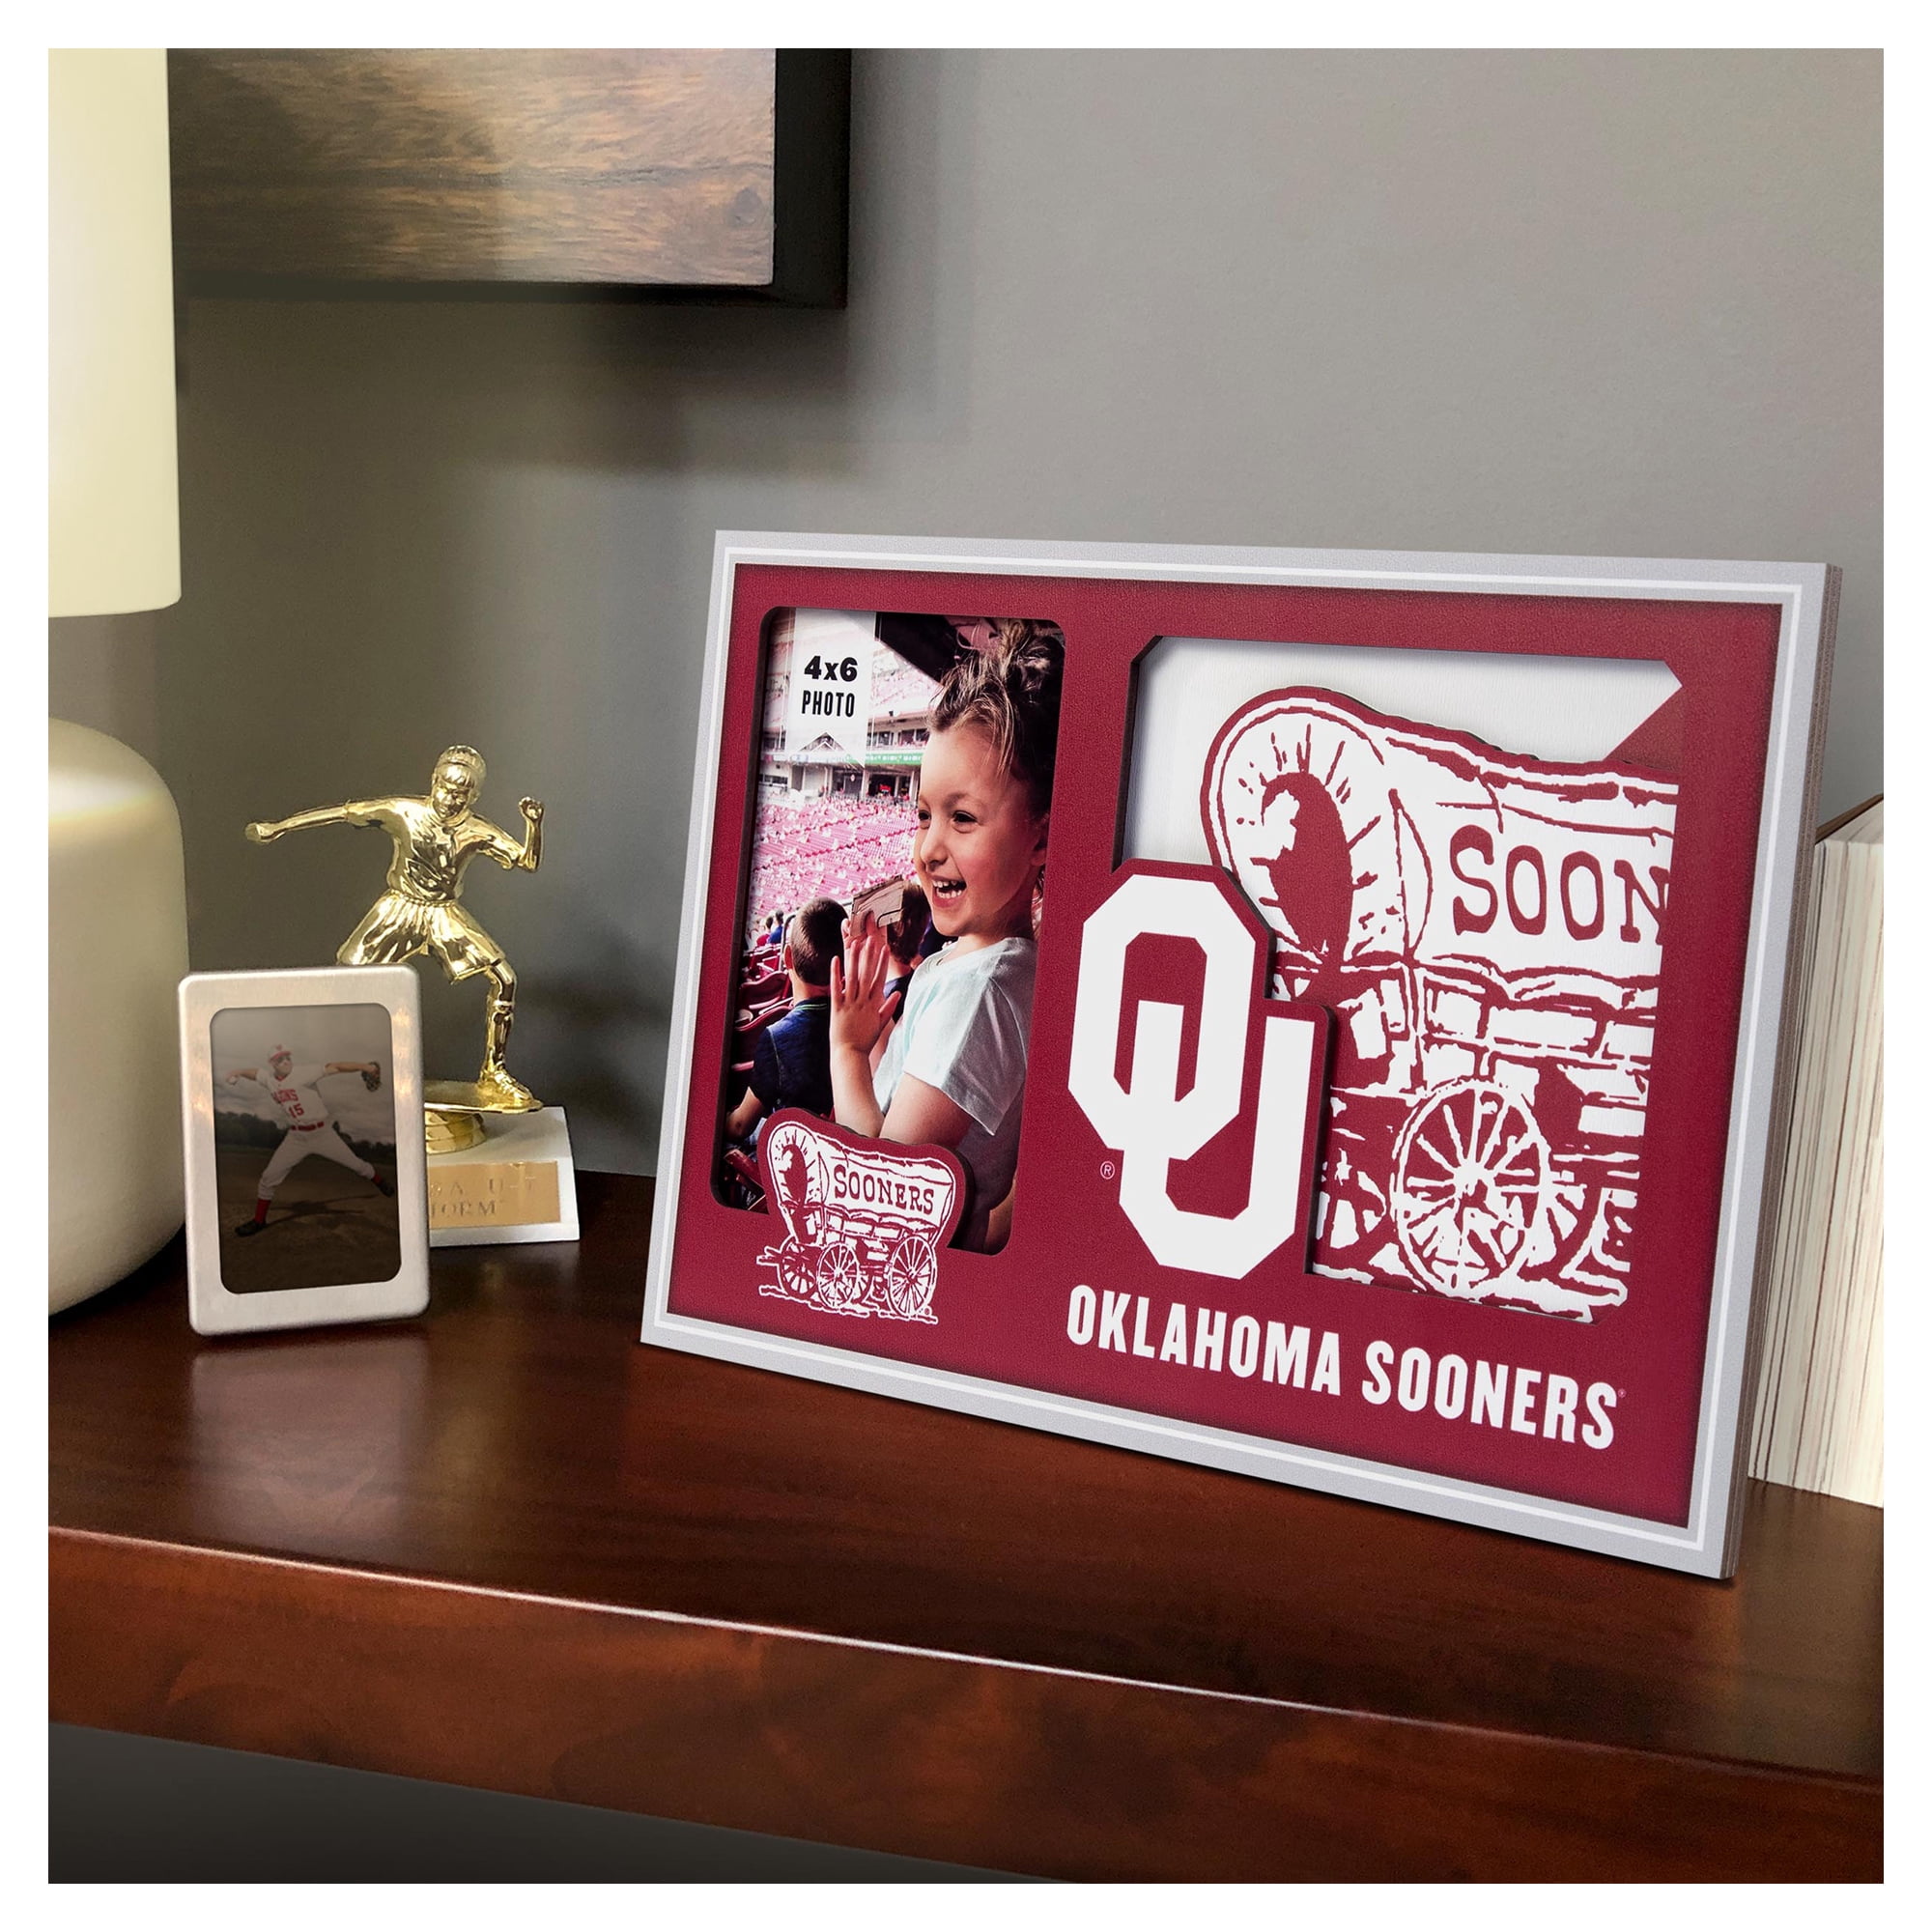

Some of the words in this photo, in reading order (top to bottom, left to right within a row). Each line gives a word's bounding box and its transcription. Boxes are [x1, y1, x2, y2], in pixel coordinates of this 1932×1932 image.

[804, 655, 858, 682] 4x6
[801, 690, 856, 718] PHOTO
[1067, 873, 1316, 1280] OU
[288, 1103, 305, 1119] 15
[833, 1163, 935, 1215] SOONERS
[1066, 1284, 1341, 1396] OKLAHOMA
[1361, 1340, 1617, 1450] SOONERS
